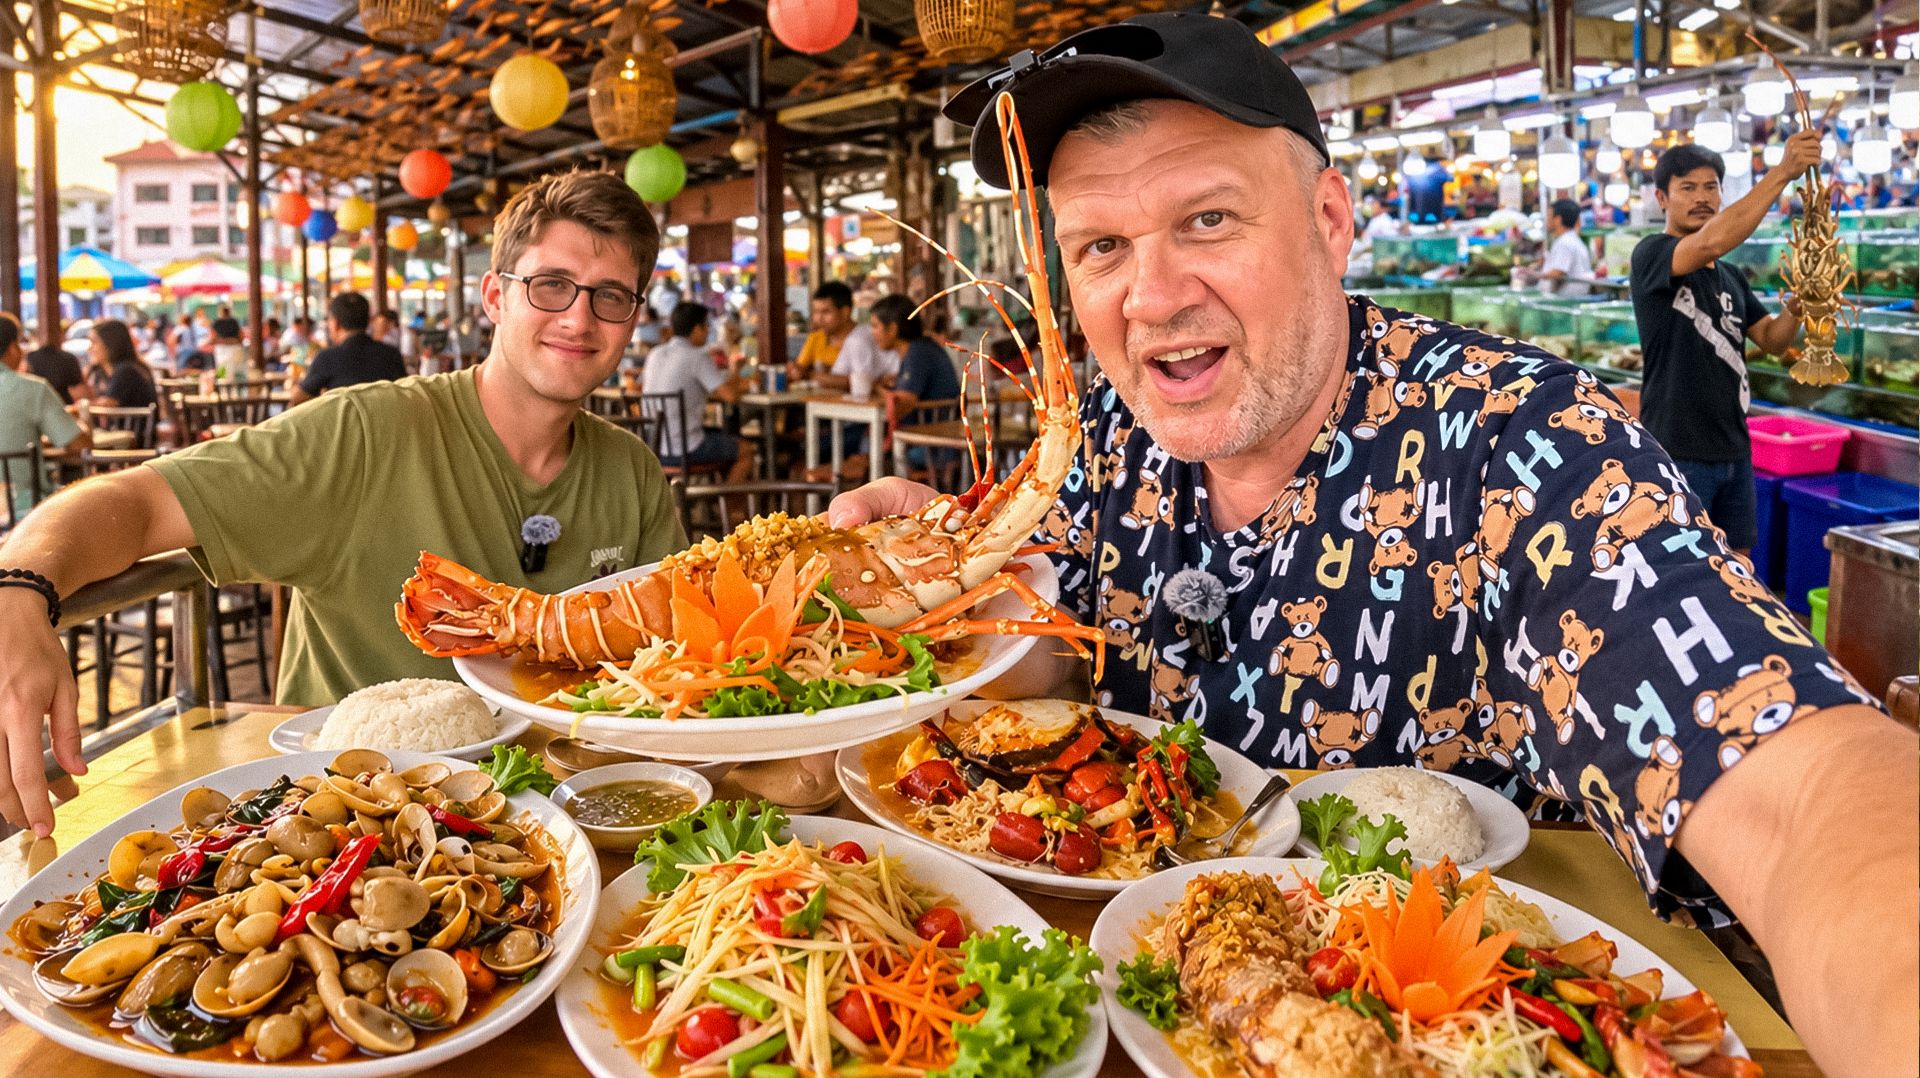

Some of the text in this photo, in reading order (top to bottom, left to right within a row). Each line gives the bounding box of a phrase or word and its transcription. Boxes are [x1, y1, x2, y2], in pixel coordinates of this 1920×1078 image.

[1413, 338, 1462, 382] H
[1325, 430, 1354, 479] D
[1439, 410, 1479, 451] W
[1395, 429, 1426, 484] R
[1506, 429, 1564, 493] H
[1425, 477, 1453, 540] H
[1226, 545, 1258, 594] S
[1271, 529, 1300, 577] H
[1354, 608, 1396, 665] N
[1652, 596, 1735, 687] H
[1229, 662, 1264, 709] X
